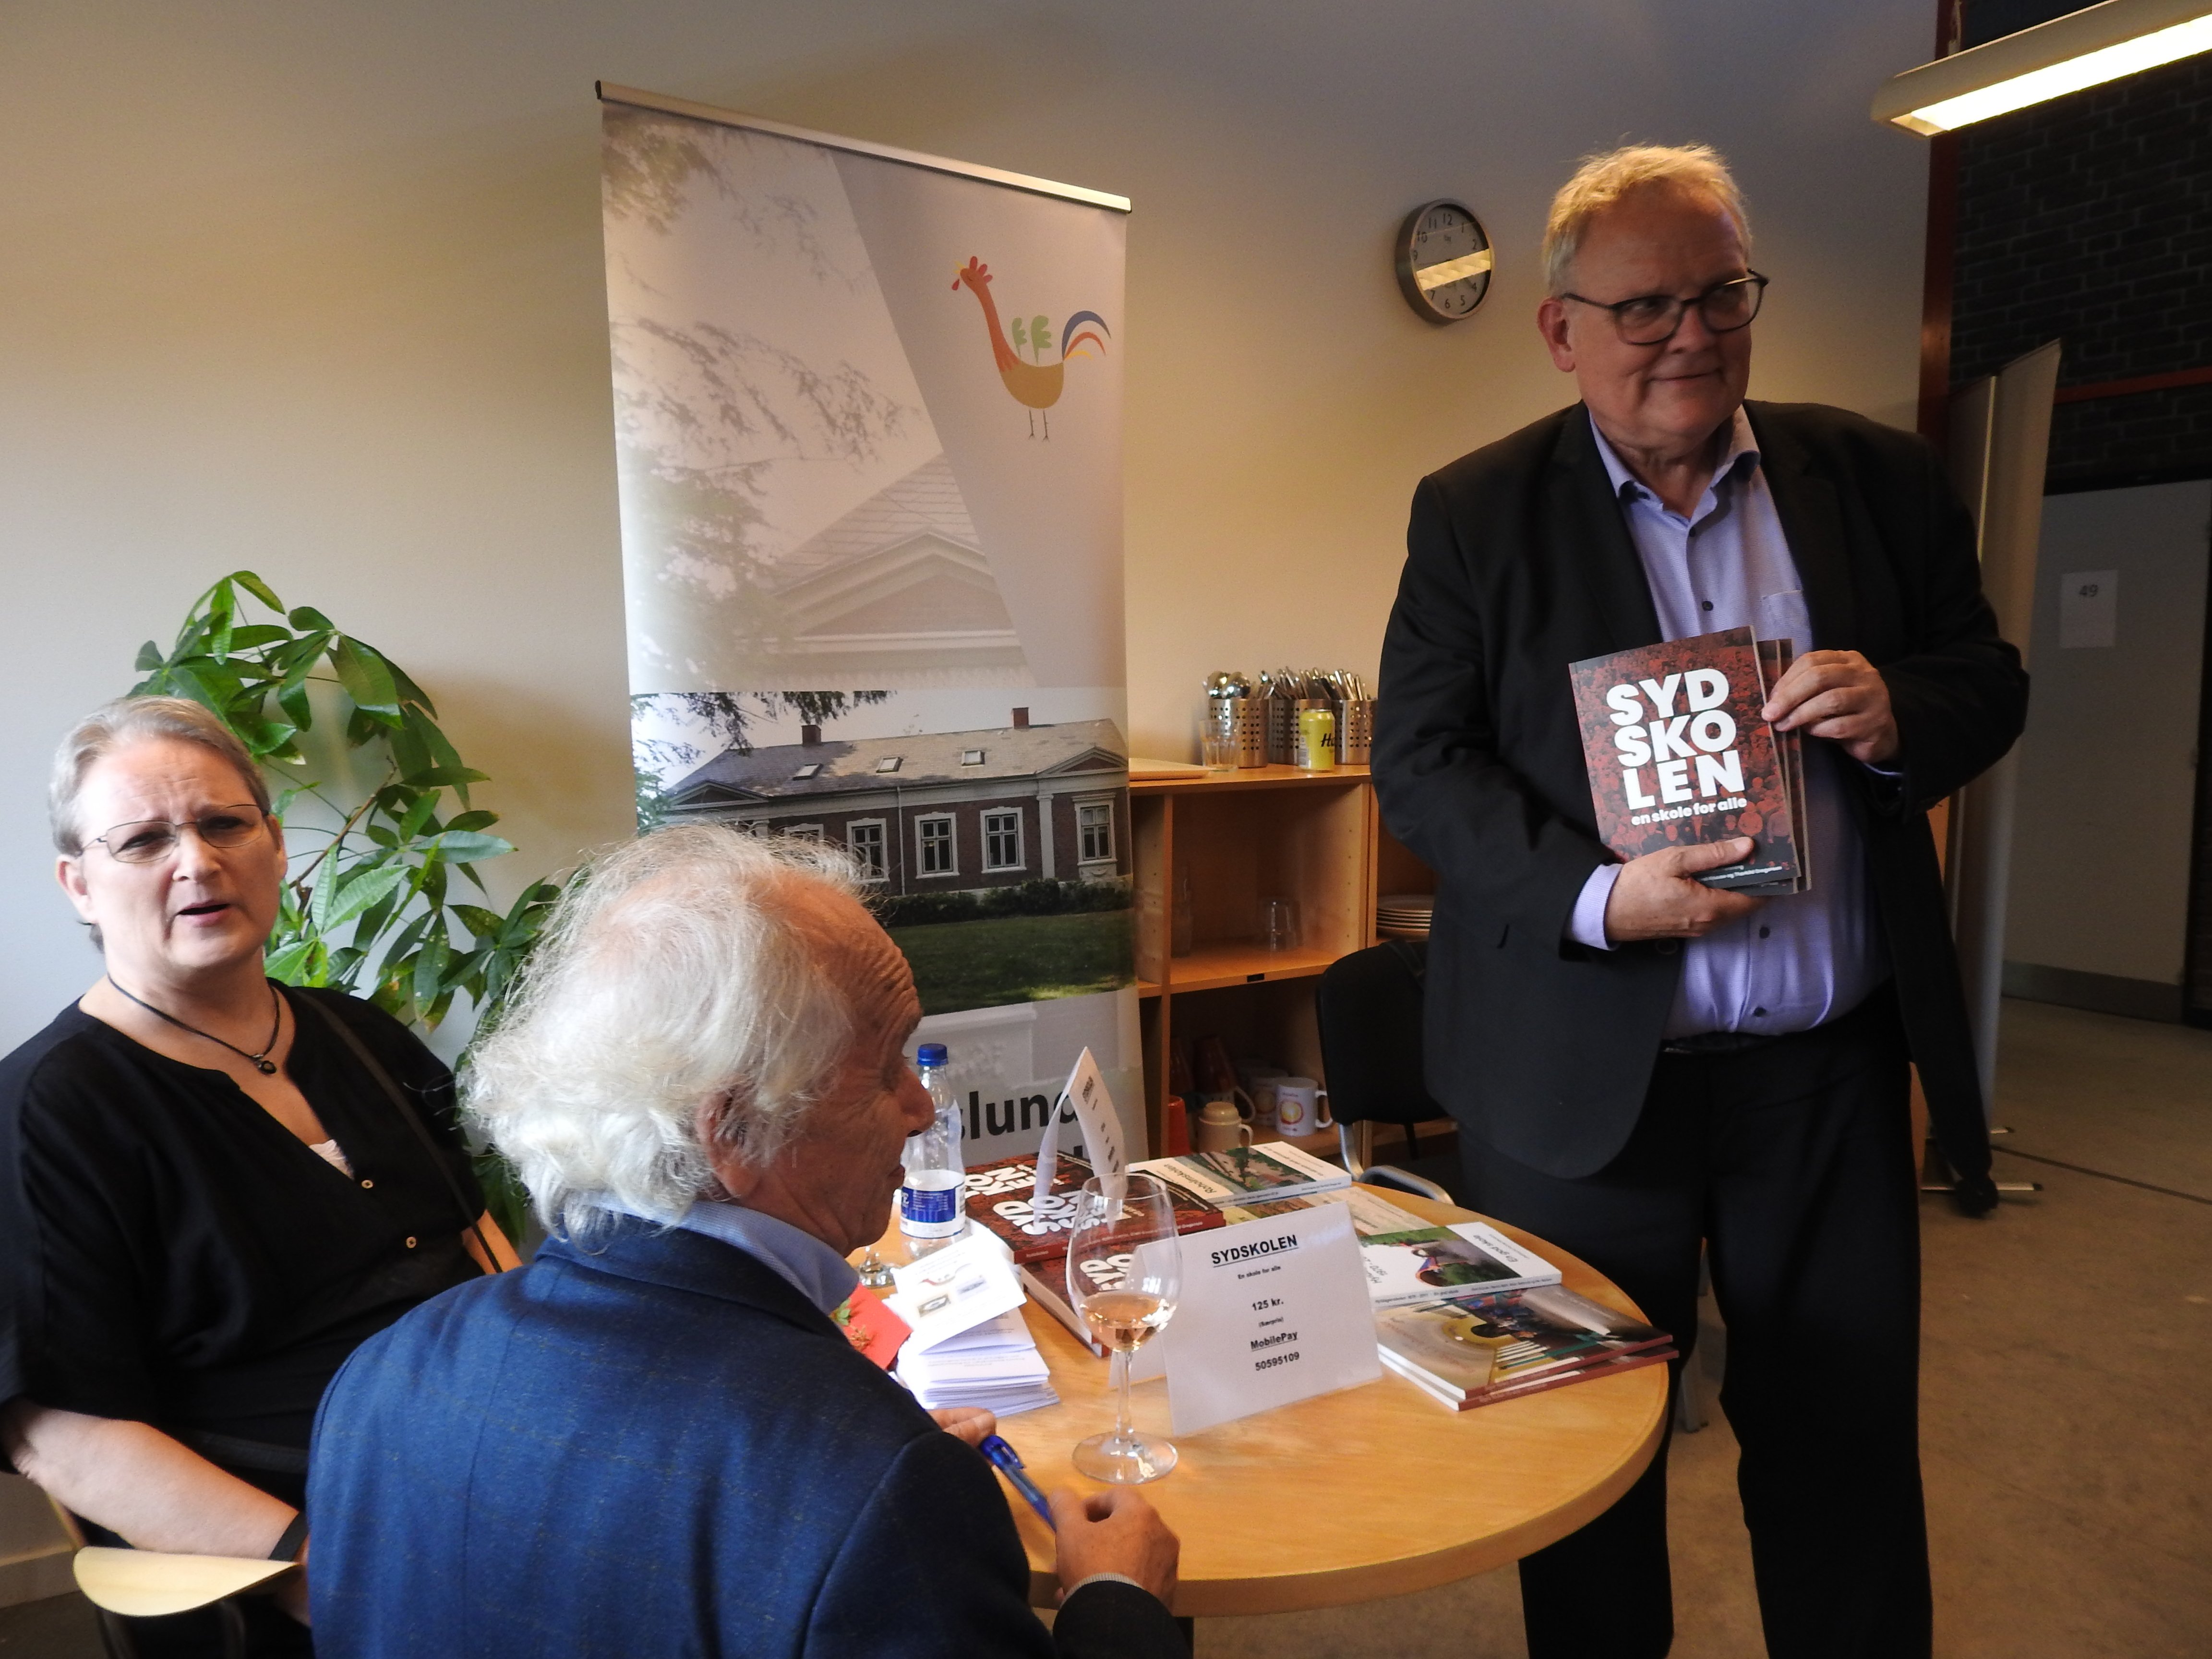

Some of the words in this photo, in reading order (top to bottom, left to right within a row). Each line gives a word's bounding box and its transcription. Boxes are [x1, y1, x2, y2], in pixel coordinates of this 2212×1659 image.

[1429, 217, 1436, 229] 11
[1443, 214, 1452, 226] 12
[1417, 231, 1428, 243] 10
[1472, 239, 1477, 250] 2
[1444, 298, 1451, 309] 6
[1461, 295, 1465, 306] 5
[2079, 584, 2098, 597] 49
[1606, 668, 1729, 726] SYD
[1614, 709, 1736, 767] SKO
[1623, 750, 1745, 810] LEN
[1631, 814, 1651, 825] en
[1651, 806, 1693, 822] skole
[1693, 802, 1716, 815] for
[1717, 797, 1747, 811] alle
[1211, 1234, 1298, 1265] SYDSKOLEN
[1252, 1302, 1269, 1311] 125
[1271, 1298, 1284, 1307] kr.
[1250, 1332, 1298, 1350] MobilePay
[1255, 1351, 1299, 1371] 50595109
